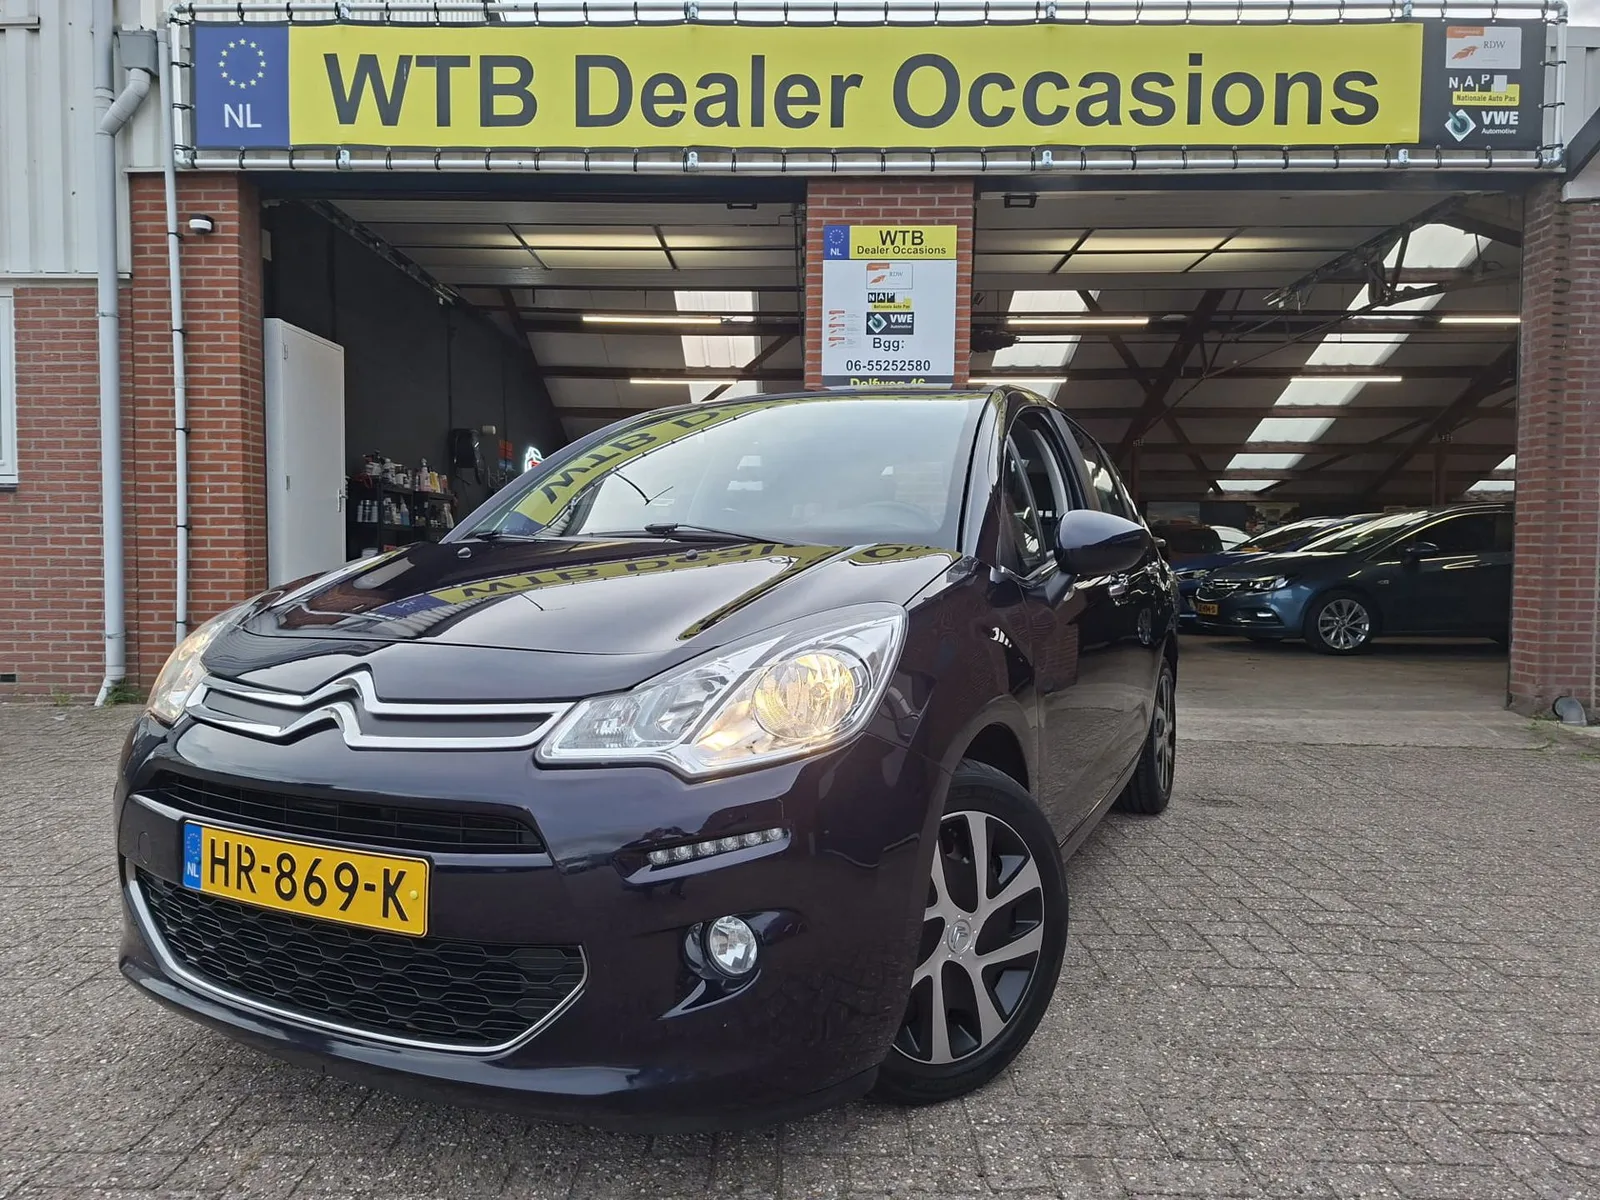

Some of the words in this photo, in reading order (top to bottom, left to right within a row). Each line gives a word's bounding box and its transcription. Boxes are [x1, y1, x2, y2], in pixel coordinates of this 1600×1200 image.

[1483, 40, 1506, 49] RDW
[323, 53, 538, 128] WTB
[575, 54, 864, 129] Dealer
[892, 52, 1380, 129] Occasions
[1456, 94, 1487, 102] Nationale
[1488, 94, 1503, 102] Auto
[1504, 94, 1517, 102] Pas
[223, 103, 262, 129] NL
[1481, 110, 1519, 125] VWE
[879, 230, 924, 246] WTB
[830, 247, 842, 256] NL
[856, 245, 890, 255] Dealer
[892, 245, 947, 255] Occasions
[889, 314, 913, 324] VWE
[872, 337, 905, 352] Bgg:
[845, 359, 931, 372] 06-55252580
[186, 862, 200, 879] NL
[208, 836, 410, 923] HR-869-K
